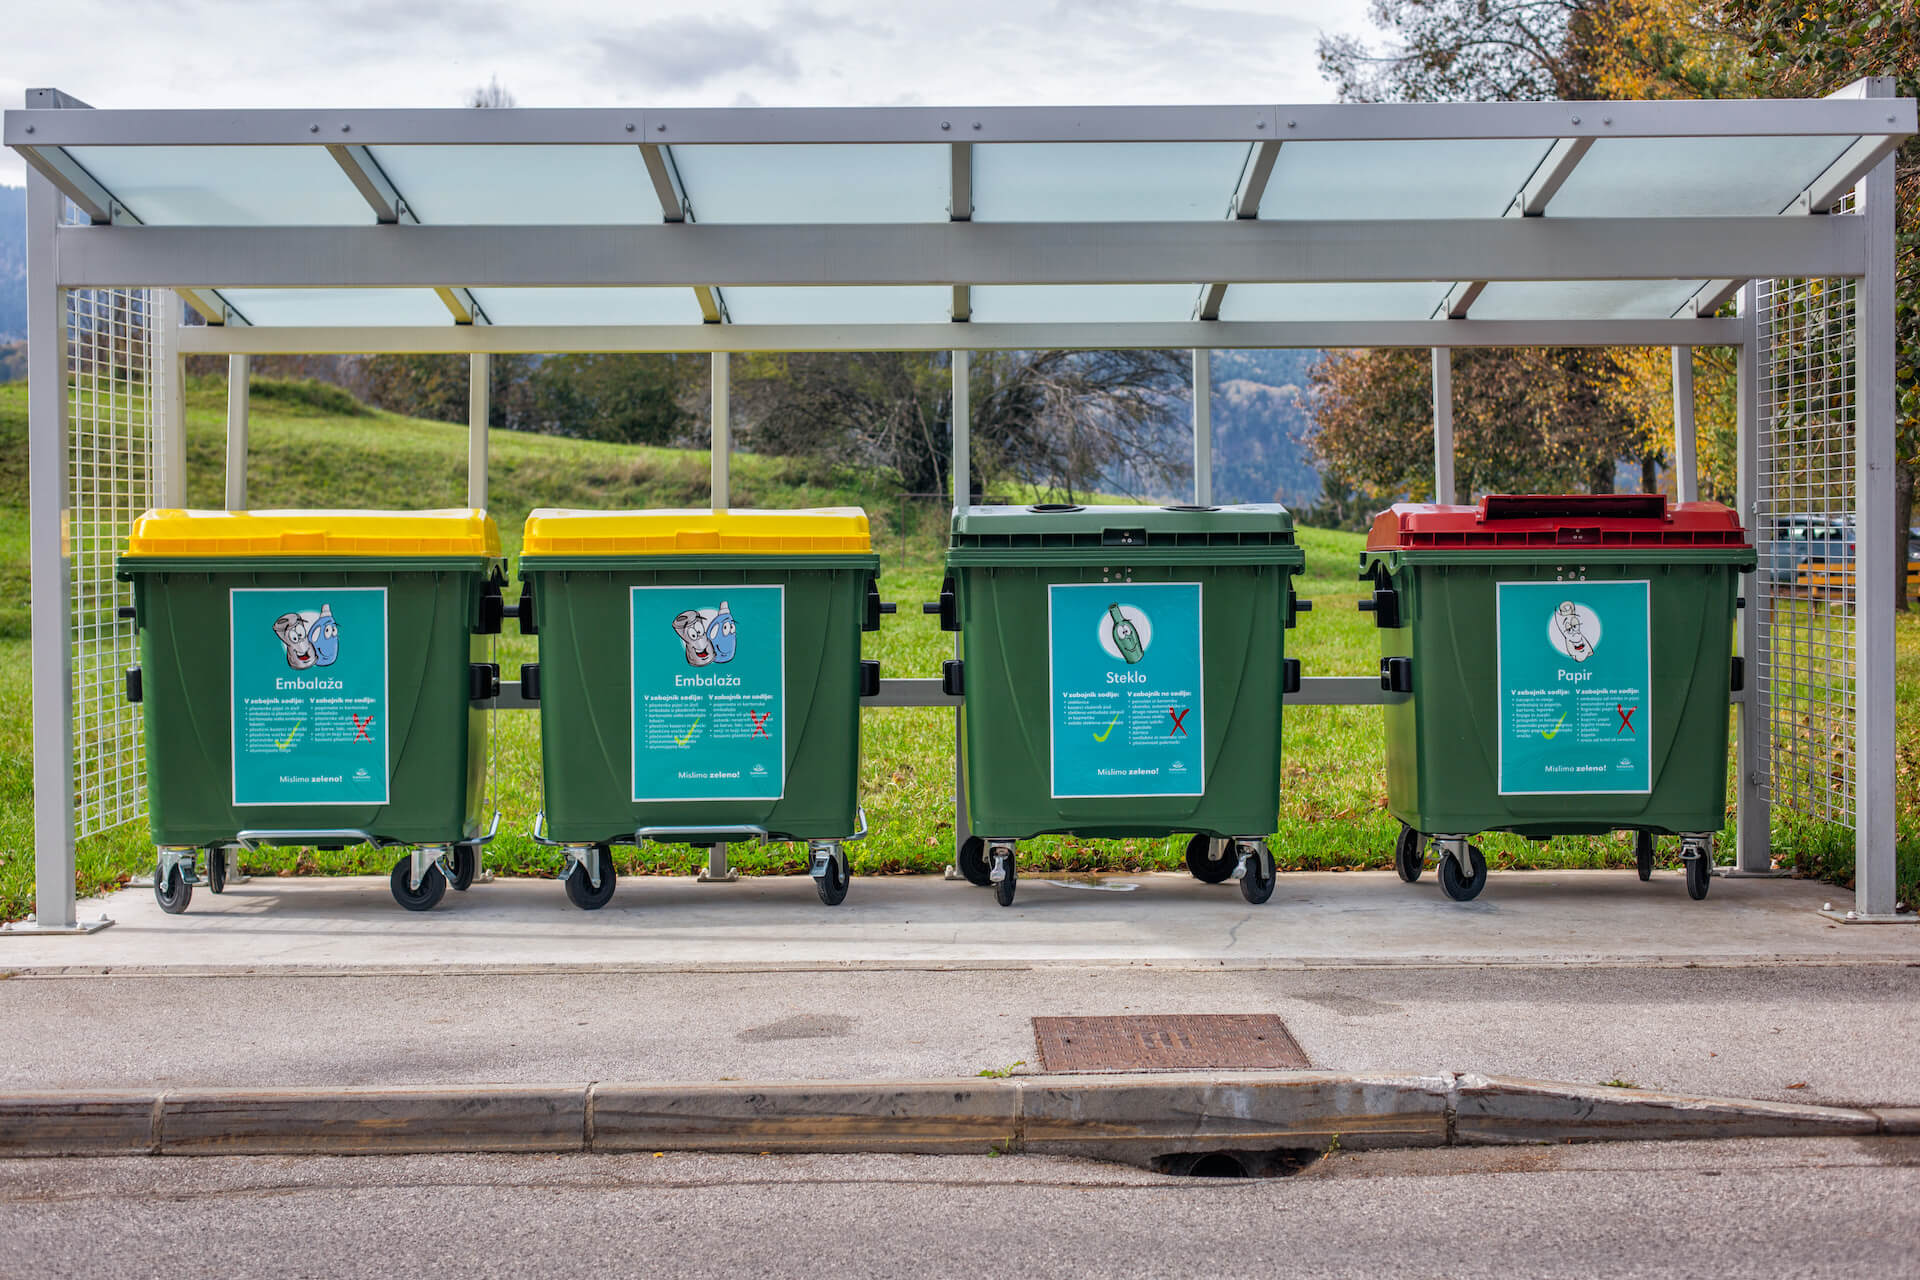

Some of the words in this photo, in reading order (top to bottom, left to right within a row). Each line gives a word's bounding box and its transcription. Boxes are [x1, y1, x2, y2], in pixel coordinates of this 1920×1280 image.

[675, 674, 741, 686] Embalaža
[1106, 671, 1147, 684] Steklo
[1558, 669, 1592, 684] Papir
[276, 677, 343, 690] Embalaža
